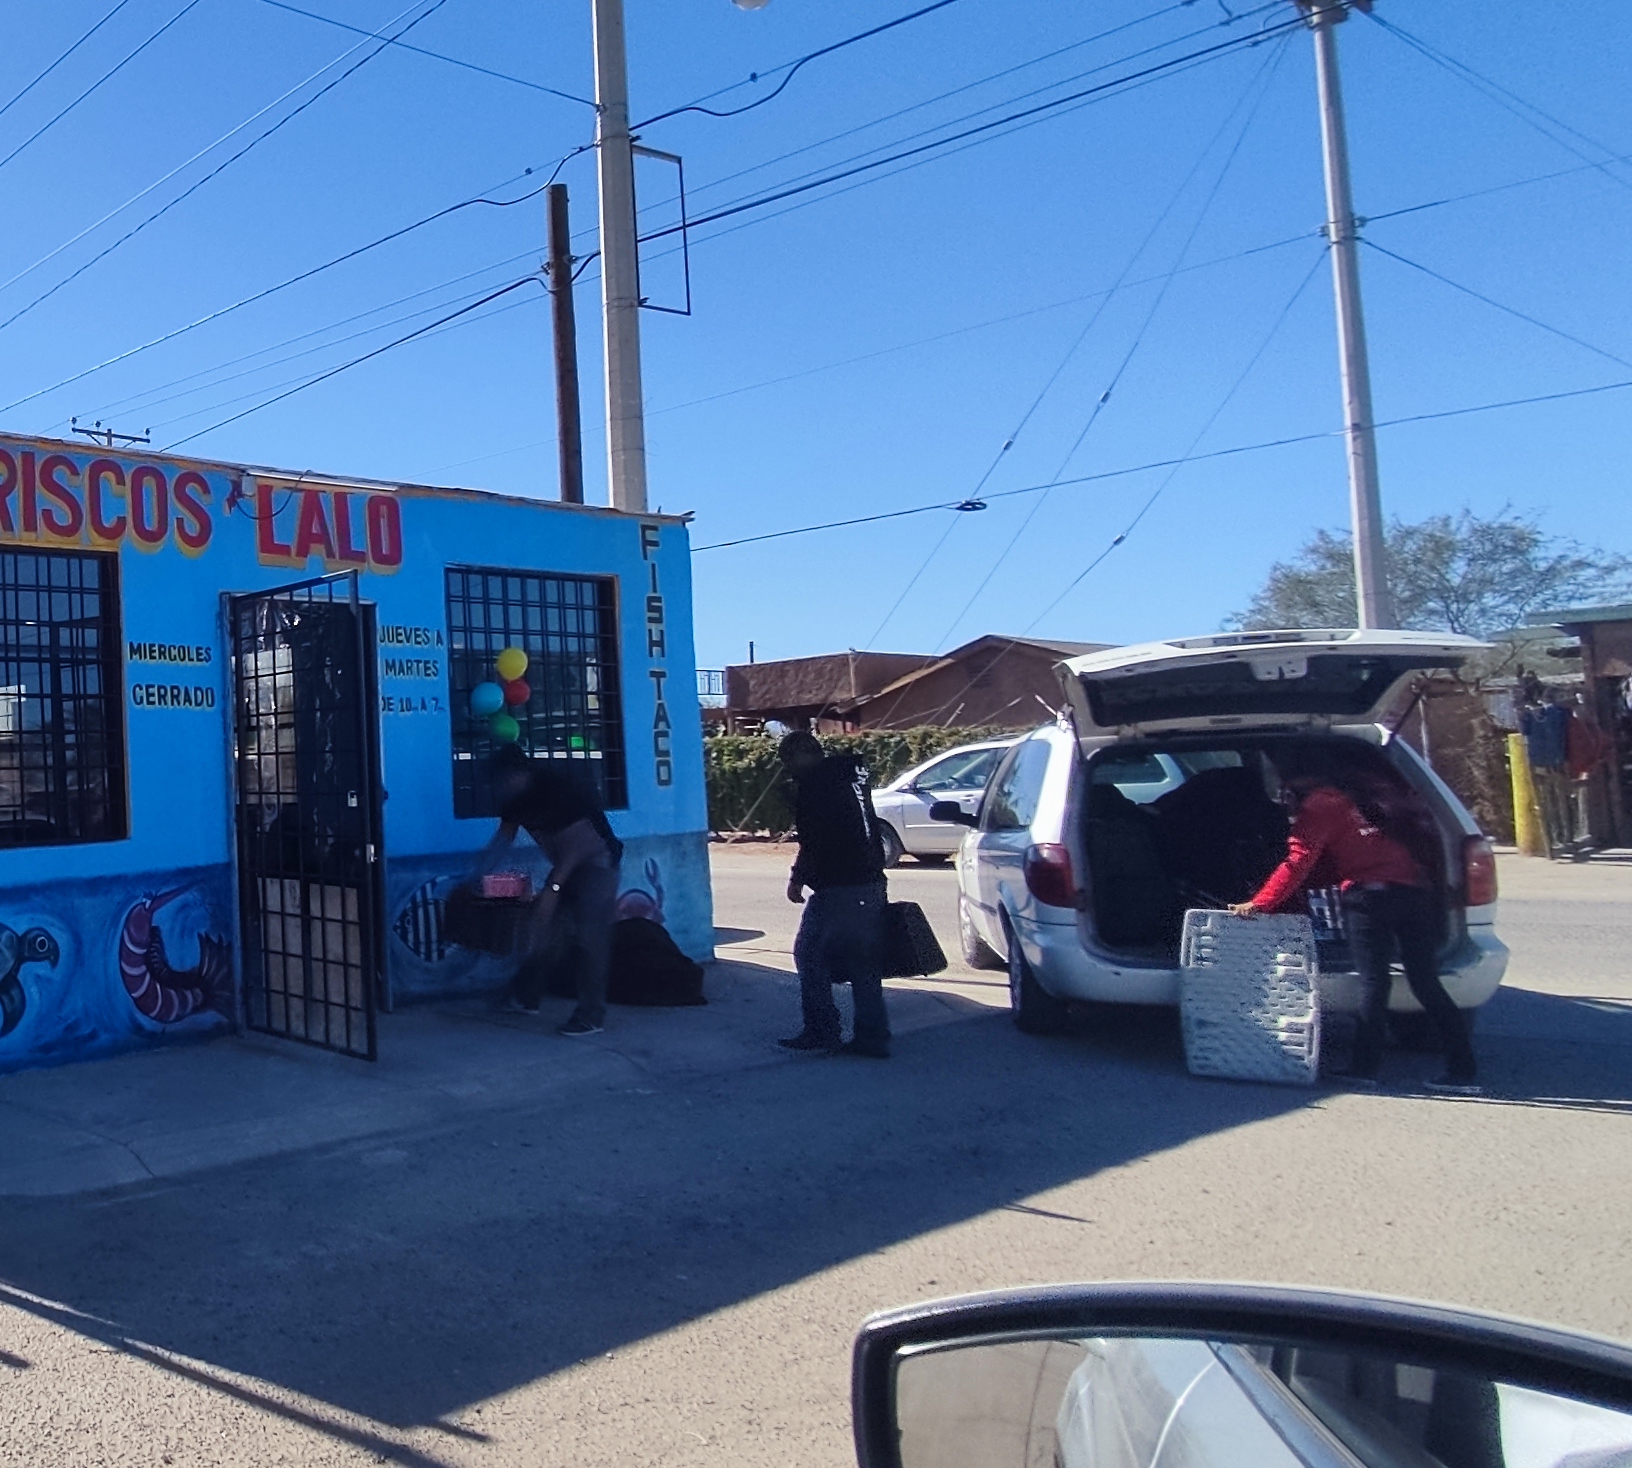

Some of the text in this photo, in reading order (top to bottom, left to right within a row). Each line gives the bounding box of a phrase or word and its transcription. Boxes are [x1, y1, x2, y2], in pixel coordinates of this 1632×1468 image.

[256, 485, 402, 574] LALO
[379, 625, 444, 647] JUEVES A
[128, 641, 213, 664] MIERCOLES
[640, 524, 672, 787] FISH TACO
[384, 659, 439, 678] MARTES
[132, 683, 216, 708] CERRADO
[420, 697, 428, 712] A
